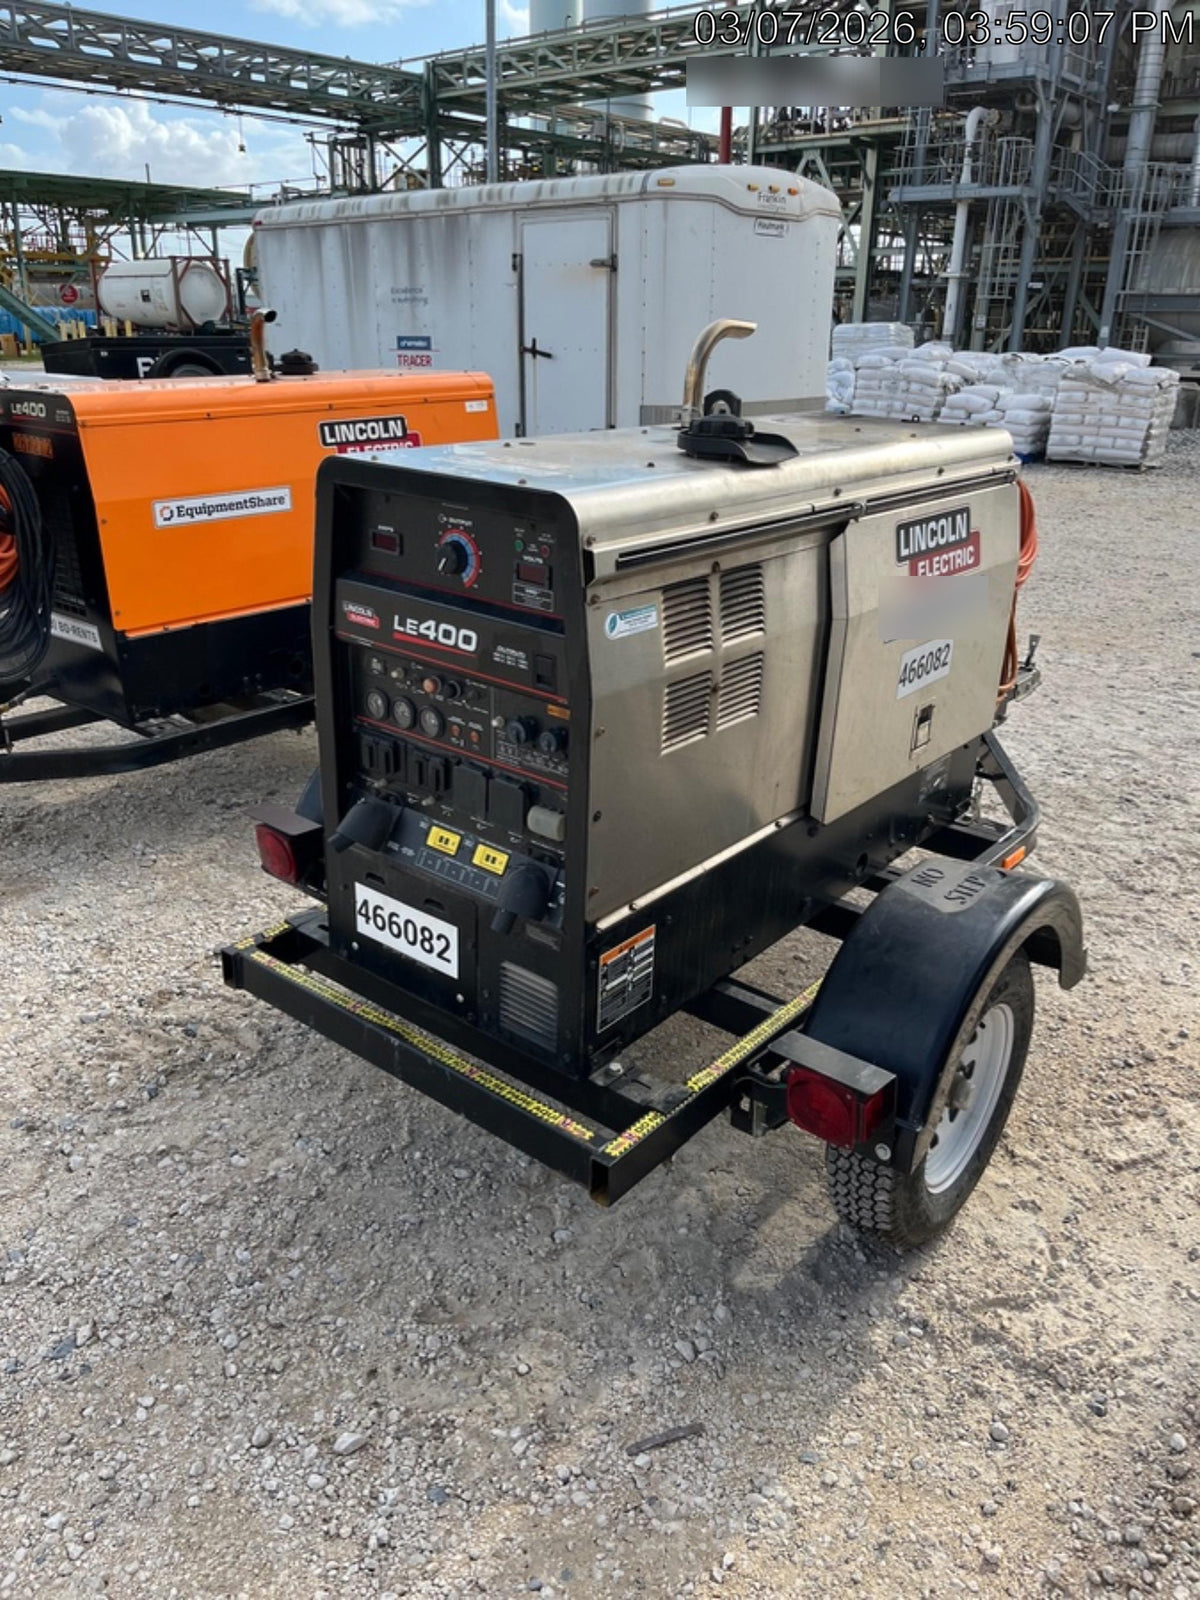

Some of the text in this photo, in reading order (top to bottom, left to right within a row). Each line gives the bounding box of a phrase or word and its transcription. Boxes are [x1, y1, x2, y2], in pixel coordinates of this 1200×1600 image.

[397, 354, 433, 367] TRACER
[10, 401, 47, 417] LE400
[323, 418, 404, 445] LINCOLN
[176, 494, 286, 519] EquipmentShare
[898, 511, 968, 557] LINCOLN
[916, 545, 975, 577] ELECTRIC
[393, 614, 478, 652] LE400
[899, 643, 951, 687] 466082
[910, 867, 945, 888] NO
[357, 898, 453, 965] 466082
